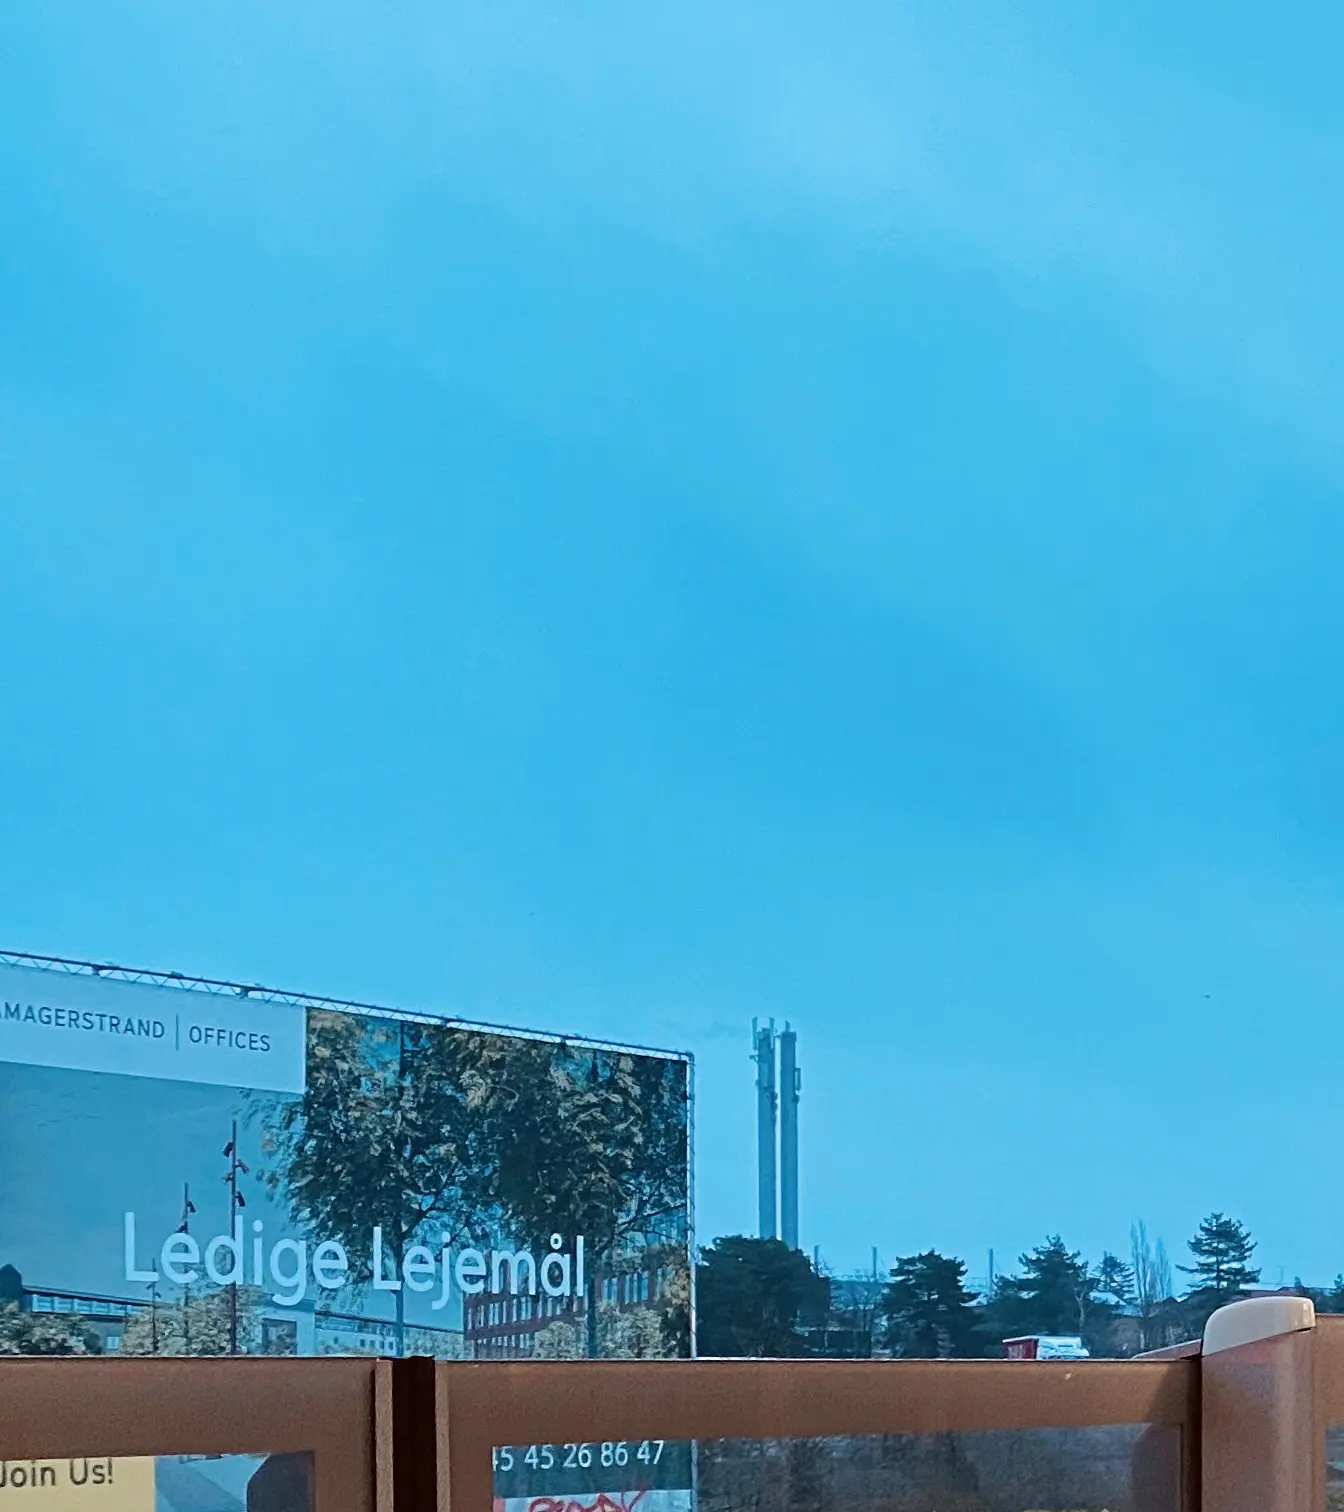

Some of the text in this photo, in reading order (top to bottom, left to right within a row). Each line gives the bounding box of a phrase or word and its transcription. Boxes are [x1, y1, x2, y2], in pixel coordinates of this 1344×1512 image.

[0, 1002, 271, 1052] MAGERSTRAND OFFICES
[124, 1212, 585, 1308] Ledige Lejemål
[69, 1457, 114, 1486] Us!
[524, 1445, 554, 1470] 45
[564, 1443, 592, 1468] 26
[600, 1442, 629, 1467] 86
[636, 1440, 665, 1465] 47
